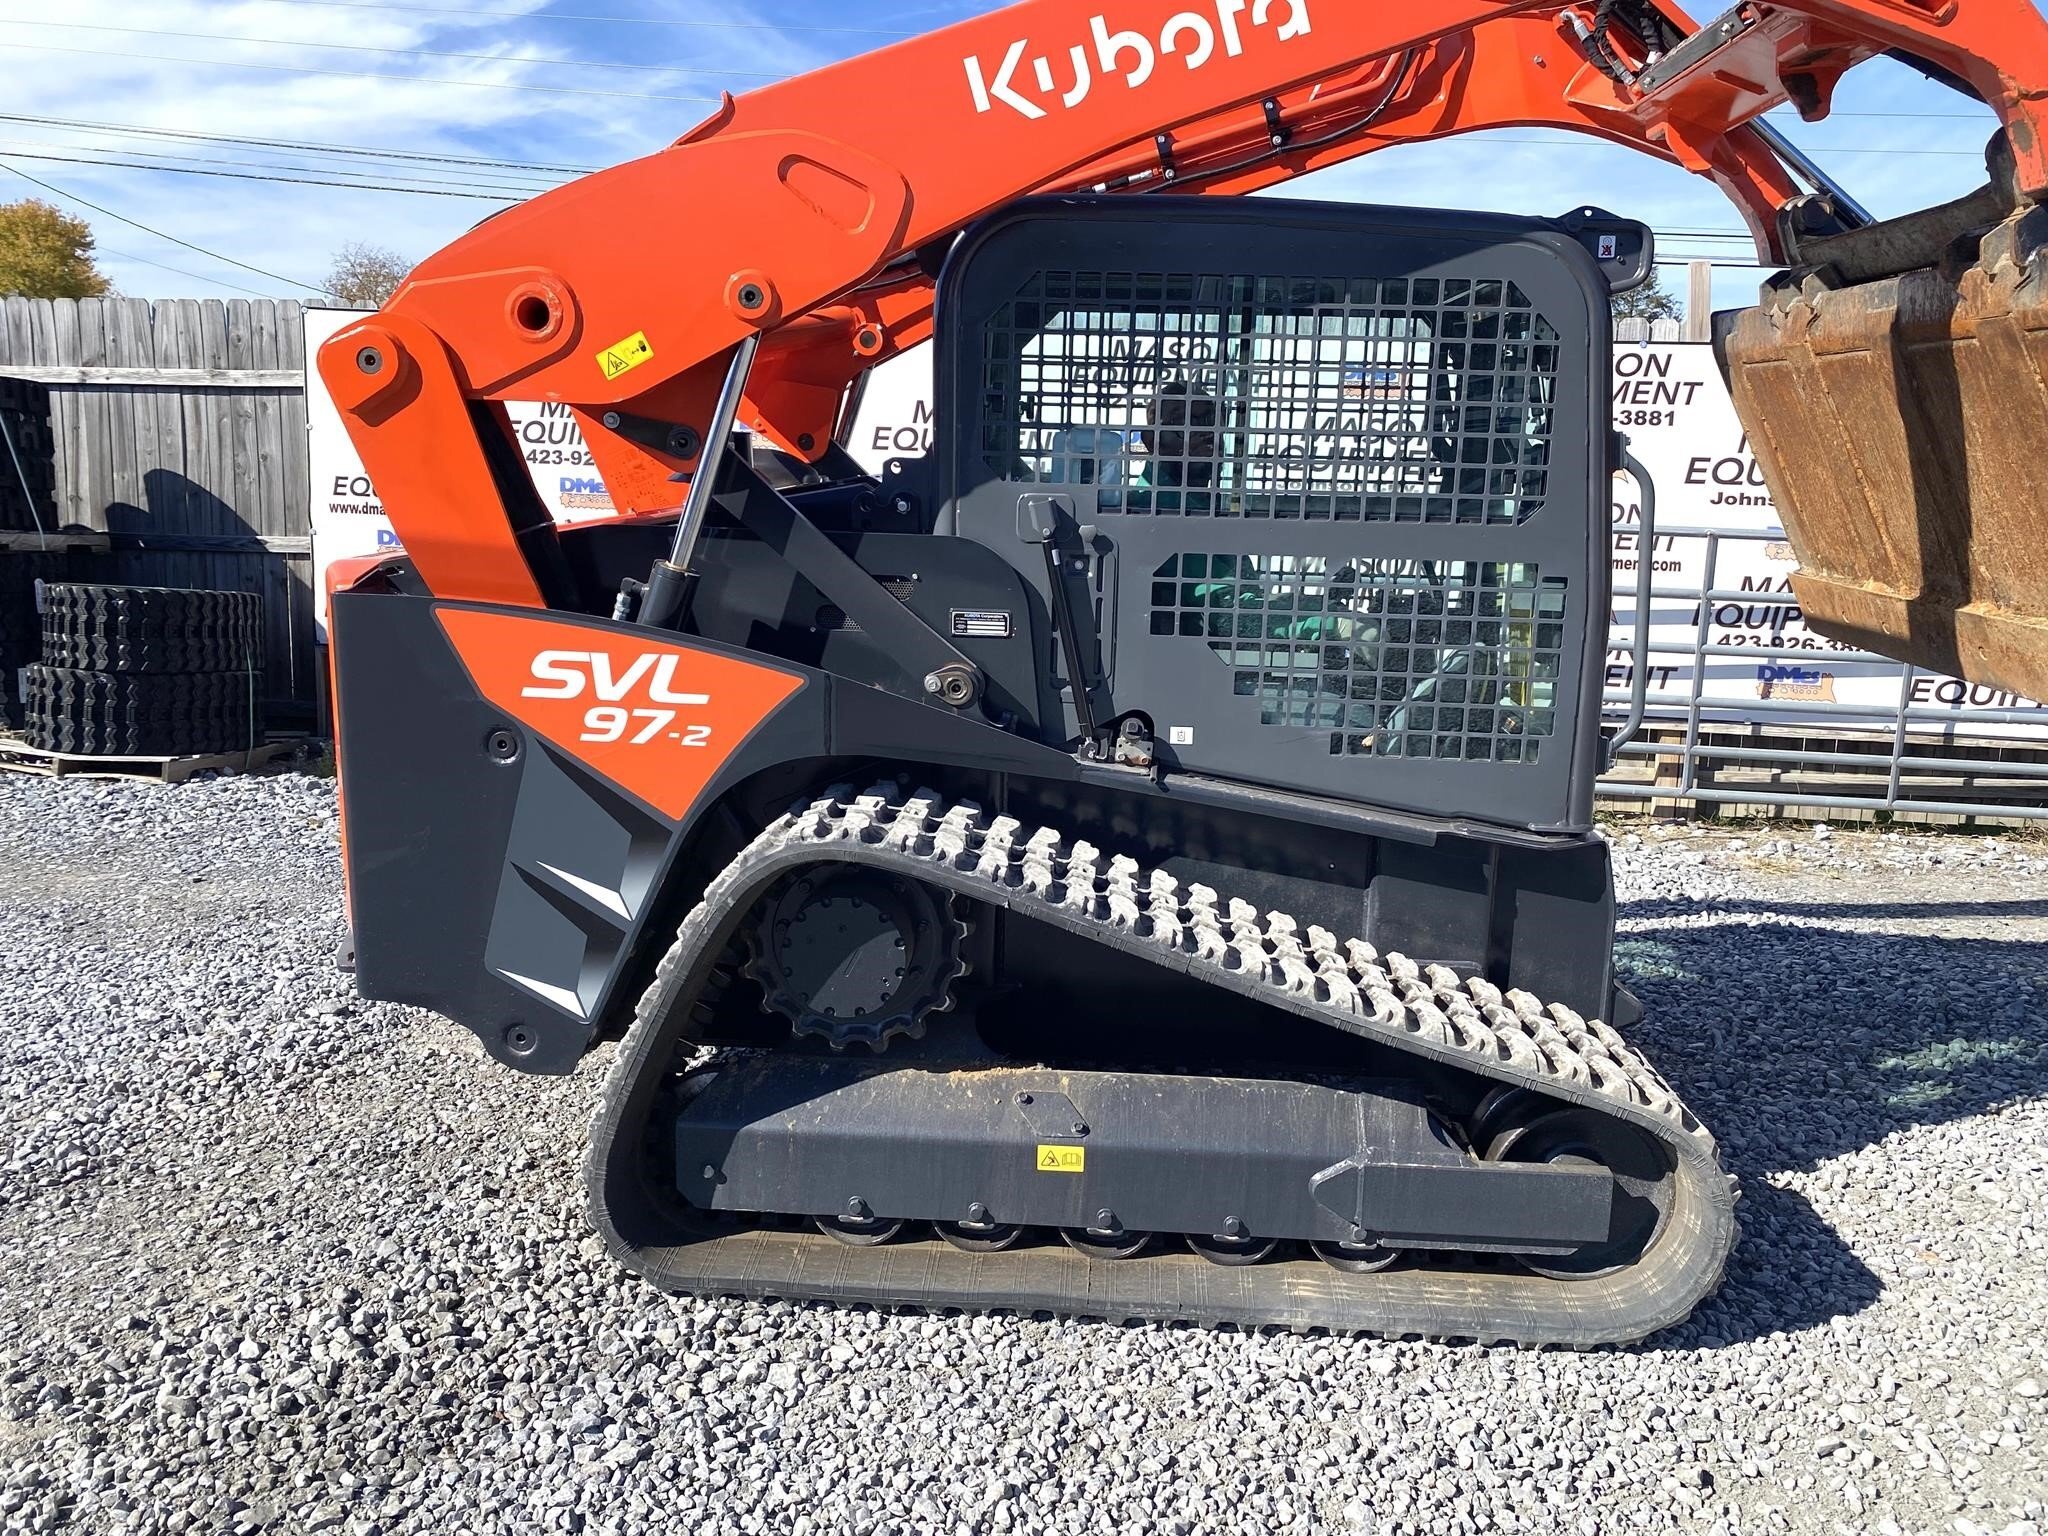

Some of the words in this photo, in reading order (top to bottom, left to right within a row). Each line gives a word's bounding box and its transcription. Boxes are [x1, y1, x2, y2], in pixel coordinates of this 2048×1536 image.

[963, 0, 1312, 120] Kubota
[521, 650, 711, 705] SVL
[579, 706, 712, 747] 97-2
